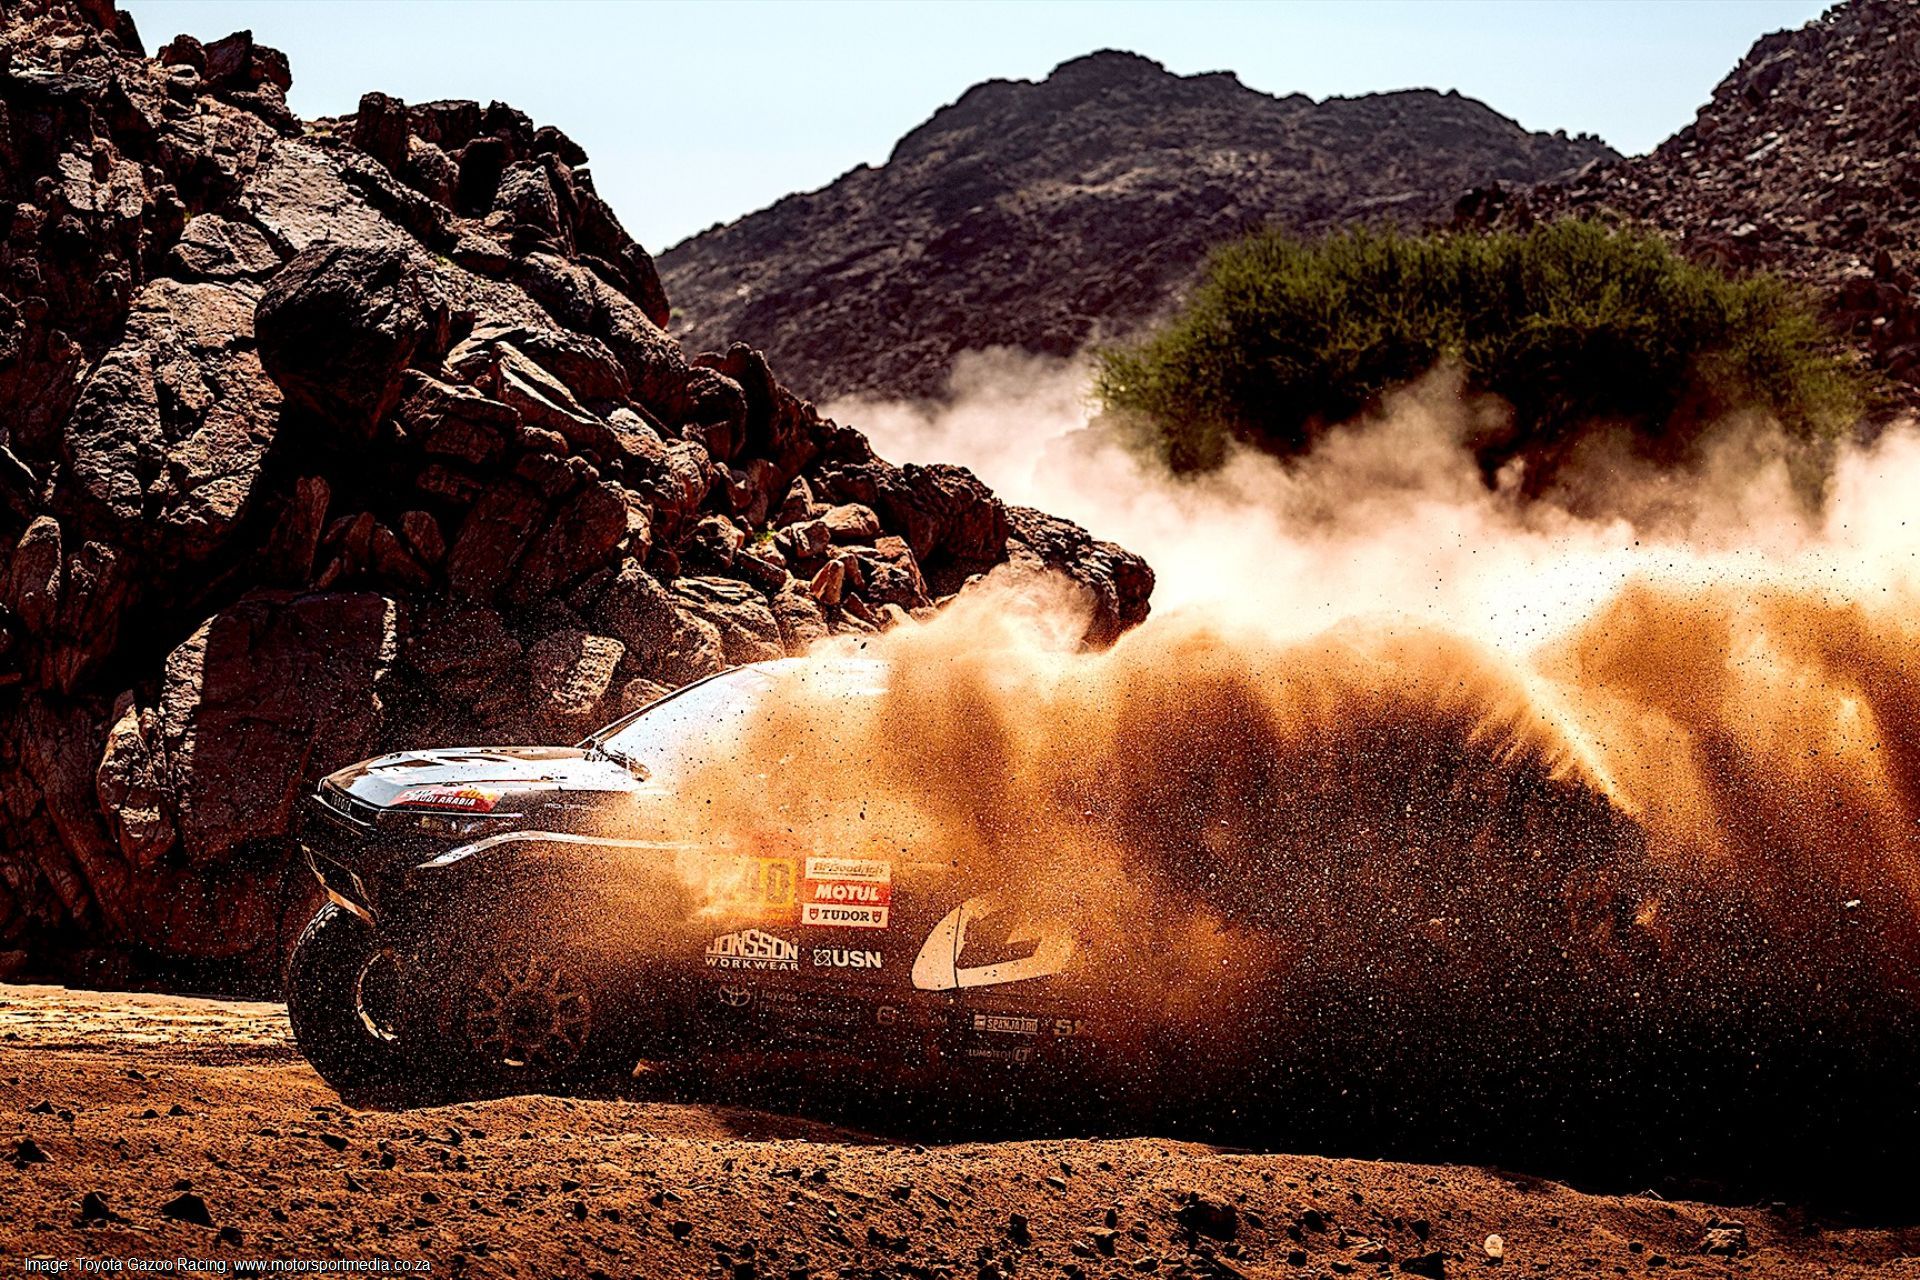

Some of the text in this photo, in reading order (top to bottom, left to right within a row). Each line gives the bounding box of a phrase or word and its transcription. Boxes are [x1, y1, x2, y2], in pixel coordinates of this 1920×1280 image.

[438, 796, 476, 807] ARABIA
[814, 884, 880, 901] MOTUL
[821, 909, 870, 922] TUDOR
[704, 928, 799, 960] JONSSON
[704, 957, 799, 971] WORKWEAR
[833, 950, 882, 969] USN
[986, 1019, 1038, 1032] SPANJAARD
